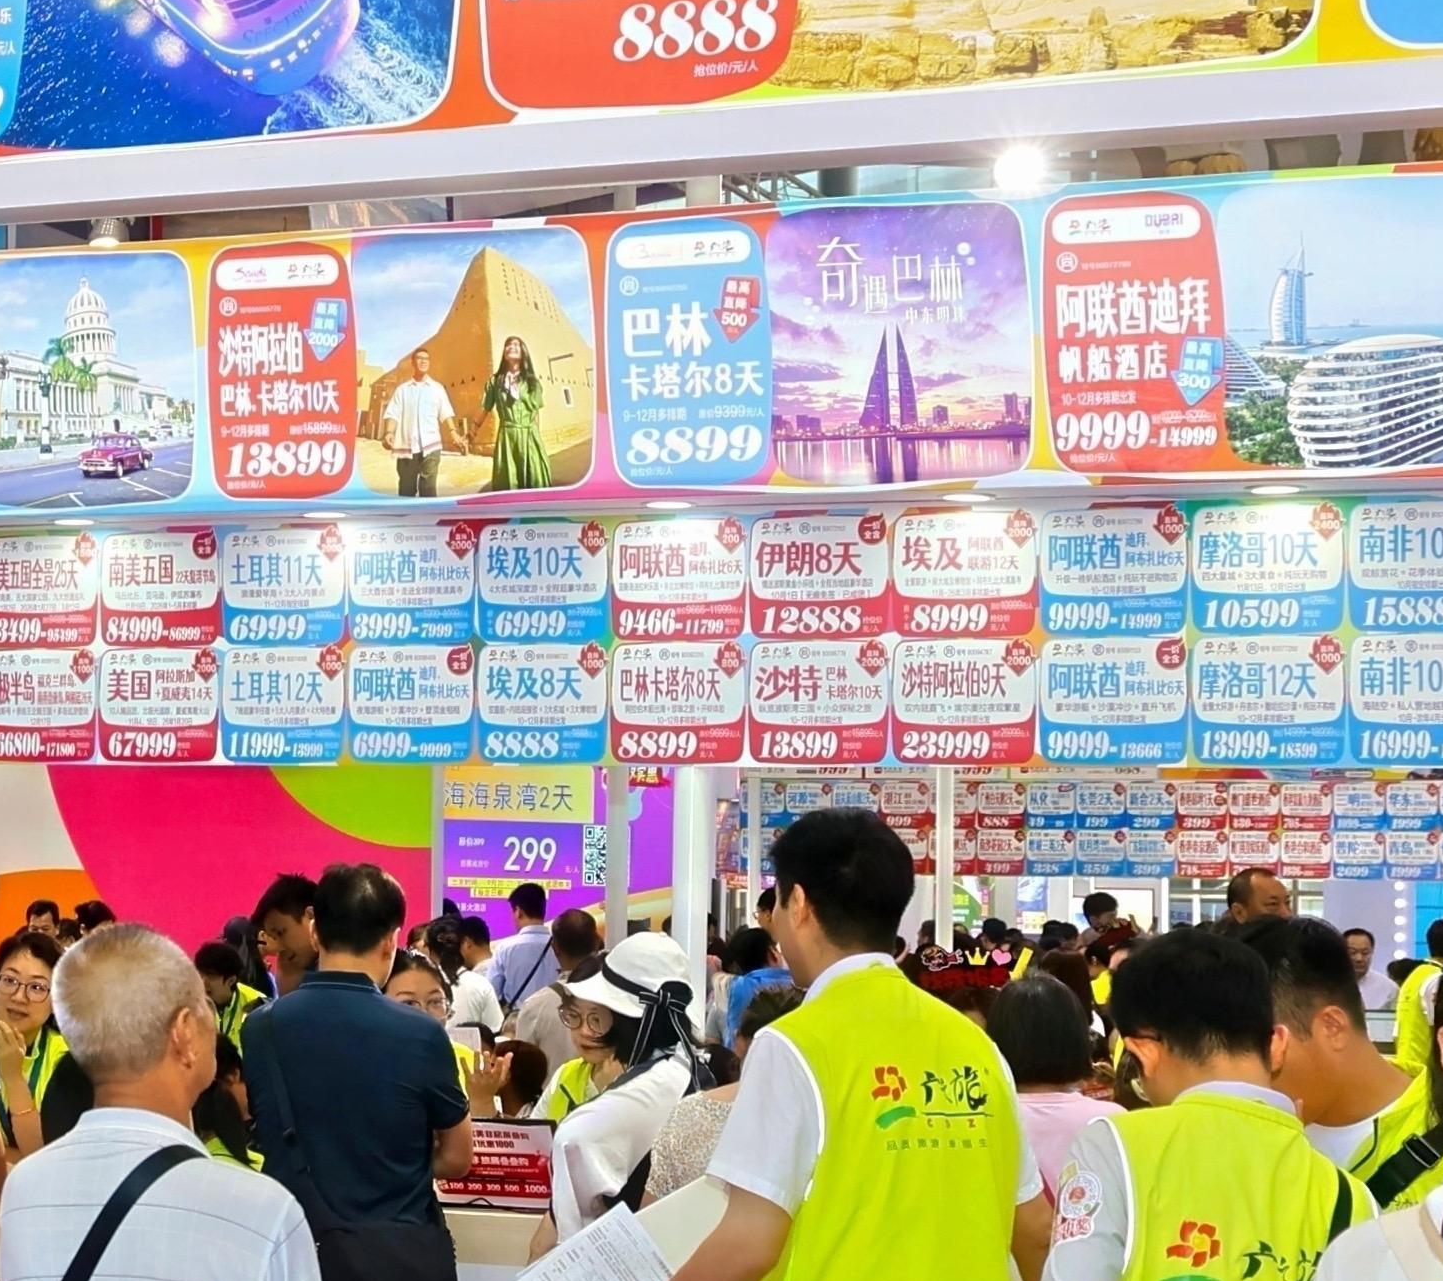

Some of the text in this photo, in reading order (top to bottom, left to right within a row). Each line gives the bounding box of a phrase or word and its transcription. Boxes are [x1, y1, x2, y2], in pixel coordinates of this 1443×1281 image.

[1144, 213, 1184, 228] DUBAI
[817, 234, 964, 315] 奇遇巴林
[1056, 278, 1212, 339] 阿联酋迪拜
[218, 320, 303, 379] 沙特阿拉伯
[622, 304, 712, 358] 巴林
[622, 358, 764, 402] 卡塔尔8天
[1058, 344, 1167, 385] 帆船酒店
[625, 425, 764, 468] 8899
[1056, 411, 1218, 451] 9999-14999
[224, 439, 344, 481] 13899
[230, 553, 323, 587] 土耳其11天
[755, 542, 863, 578] 伊朗8天
[230, 615, 307, 640] 6999
[761, 606, 863, 634] 12888
[619, 666, 722, 702] 巴林卡塔尔8天
[503, 836, 557, 872] 299
[920, 1066, 988, 1110] 广之旅
